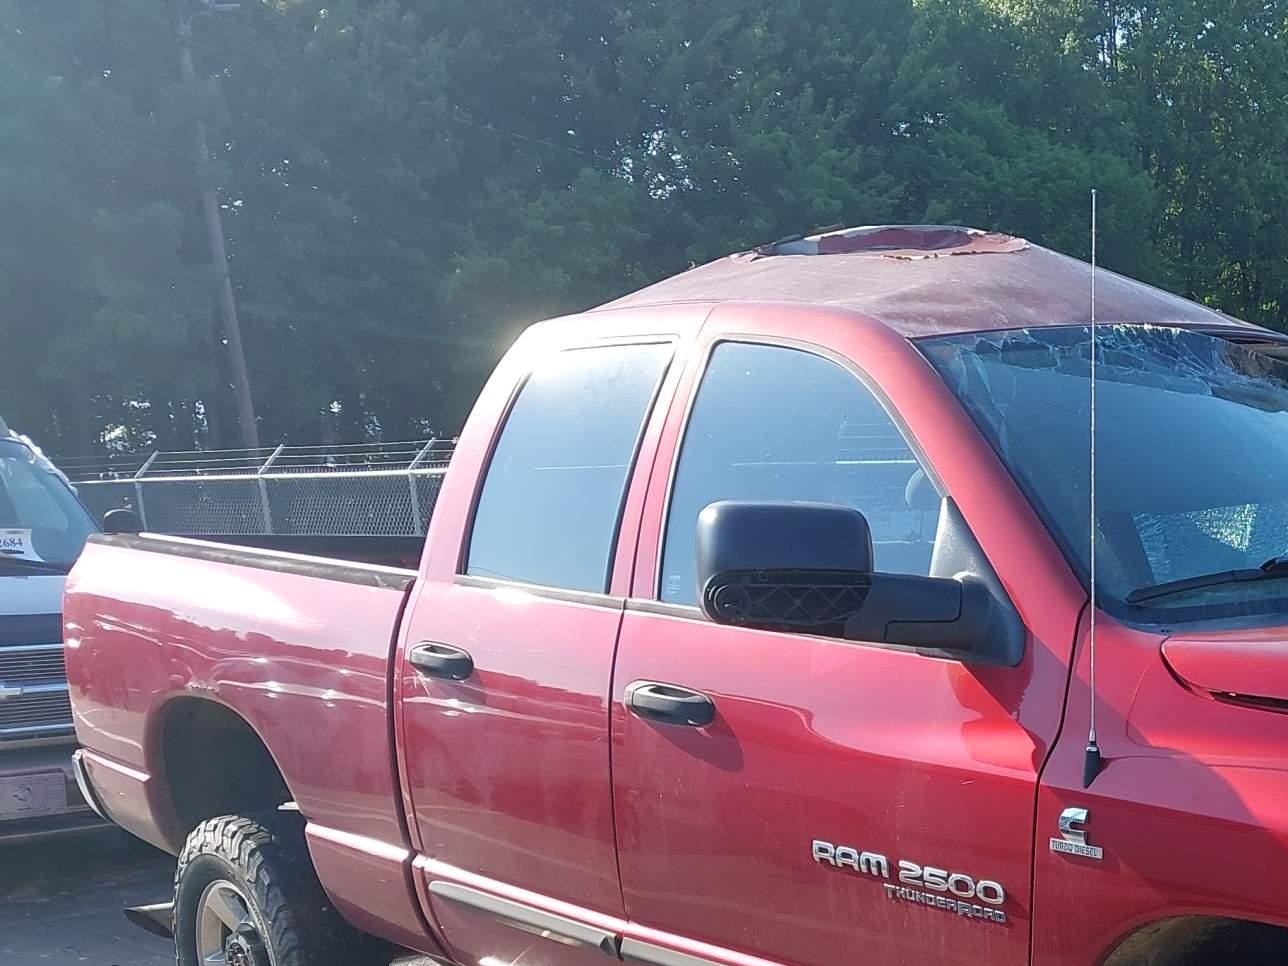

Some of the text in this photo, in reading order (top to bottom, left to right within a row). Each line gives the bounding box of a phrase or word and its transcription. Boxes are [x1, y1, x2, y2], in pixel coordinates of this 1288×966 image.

[1074, 845, 1100, 857] DIESEL
[812, 840, 1005, 905] RAM 2500
